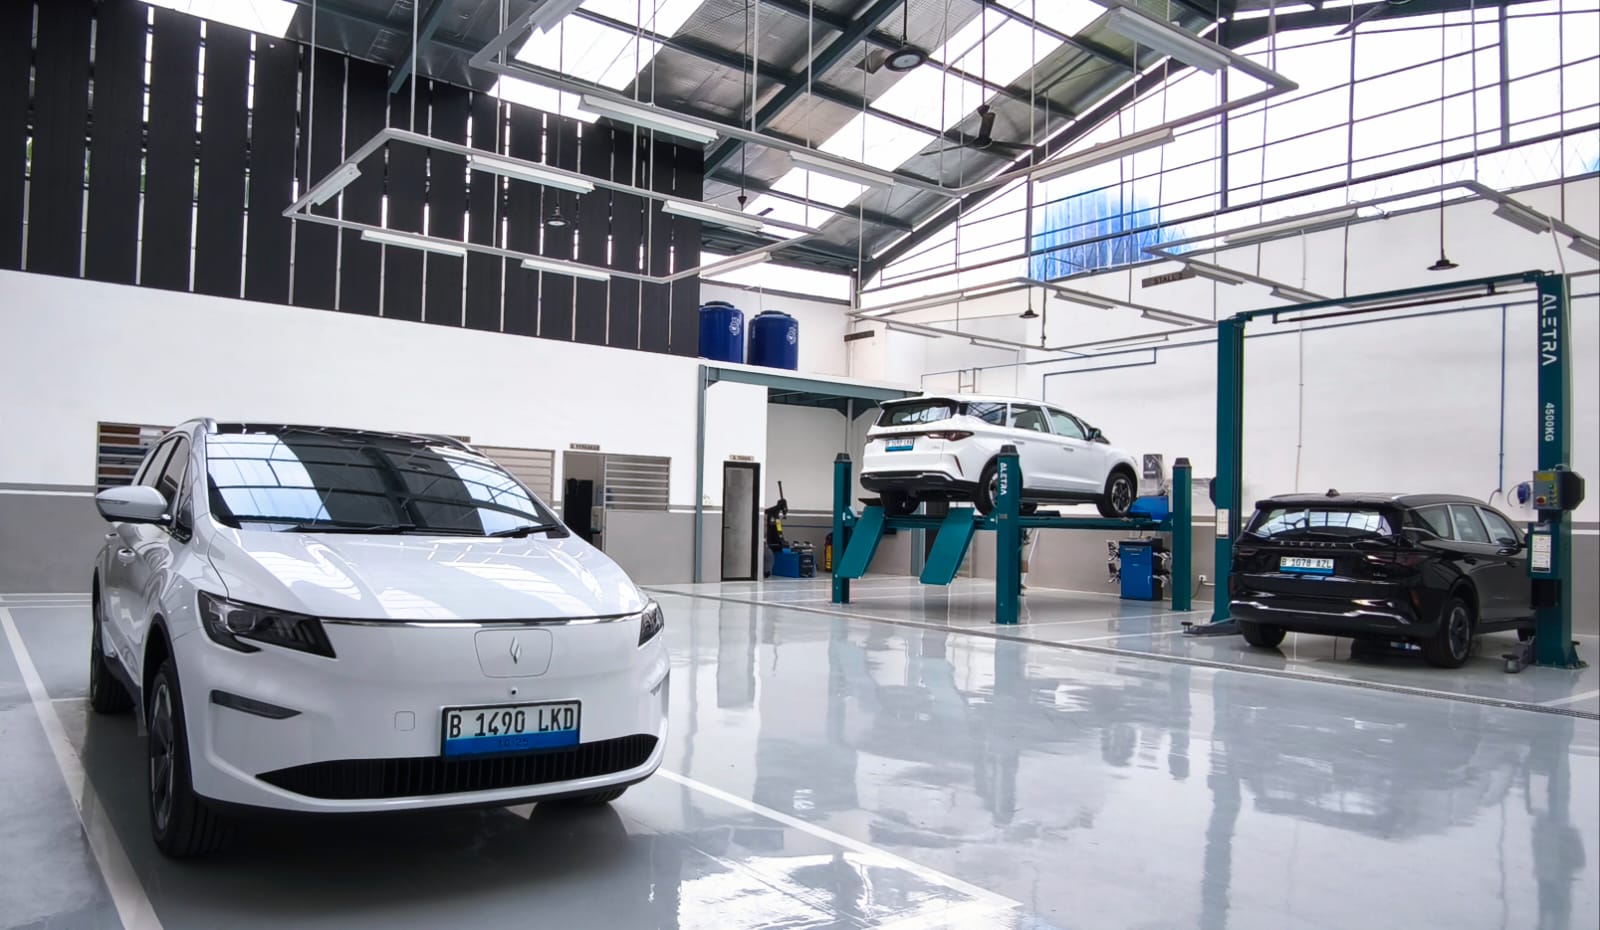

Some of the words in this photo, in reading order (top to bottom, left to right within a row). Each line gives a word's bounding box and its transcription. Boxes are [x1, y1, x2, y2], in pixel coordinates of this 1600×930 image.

[1542, 293, 1557, 366] ALETRA
[1544, 402, 1555, 442] 4500KG
[1000, 462, 1008, 496] ALETRA
[449, 714, 462, 739] B
[474, 711, 525, 737] 1490
[538, 707, 574, 732] LKD
